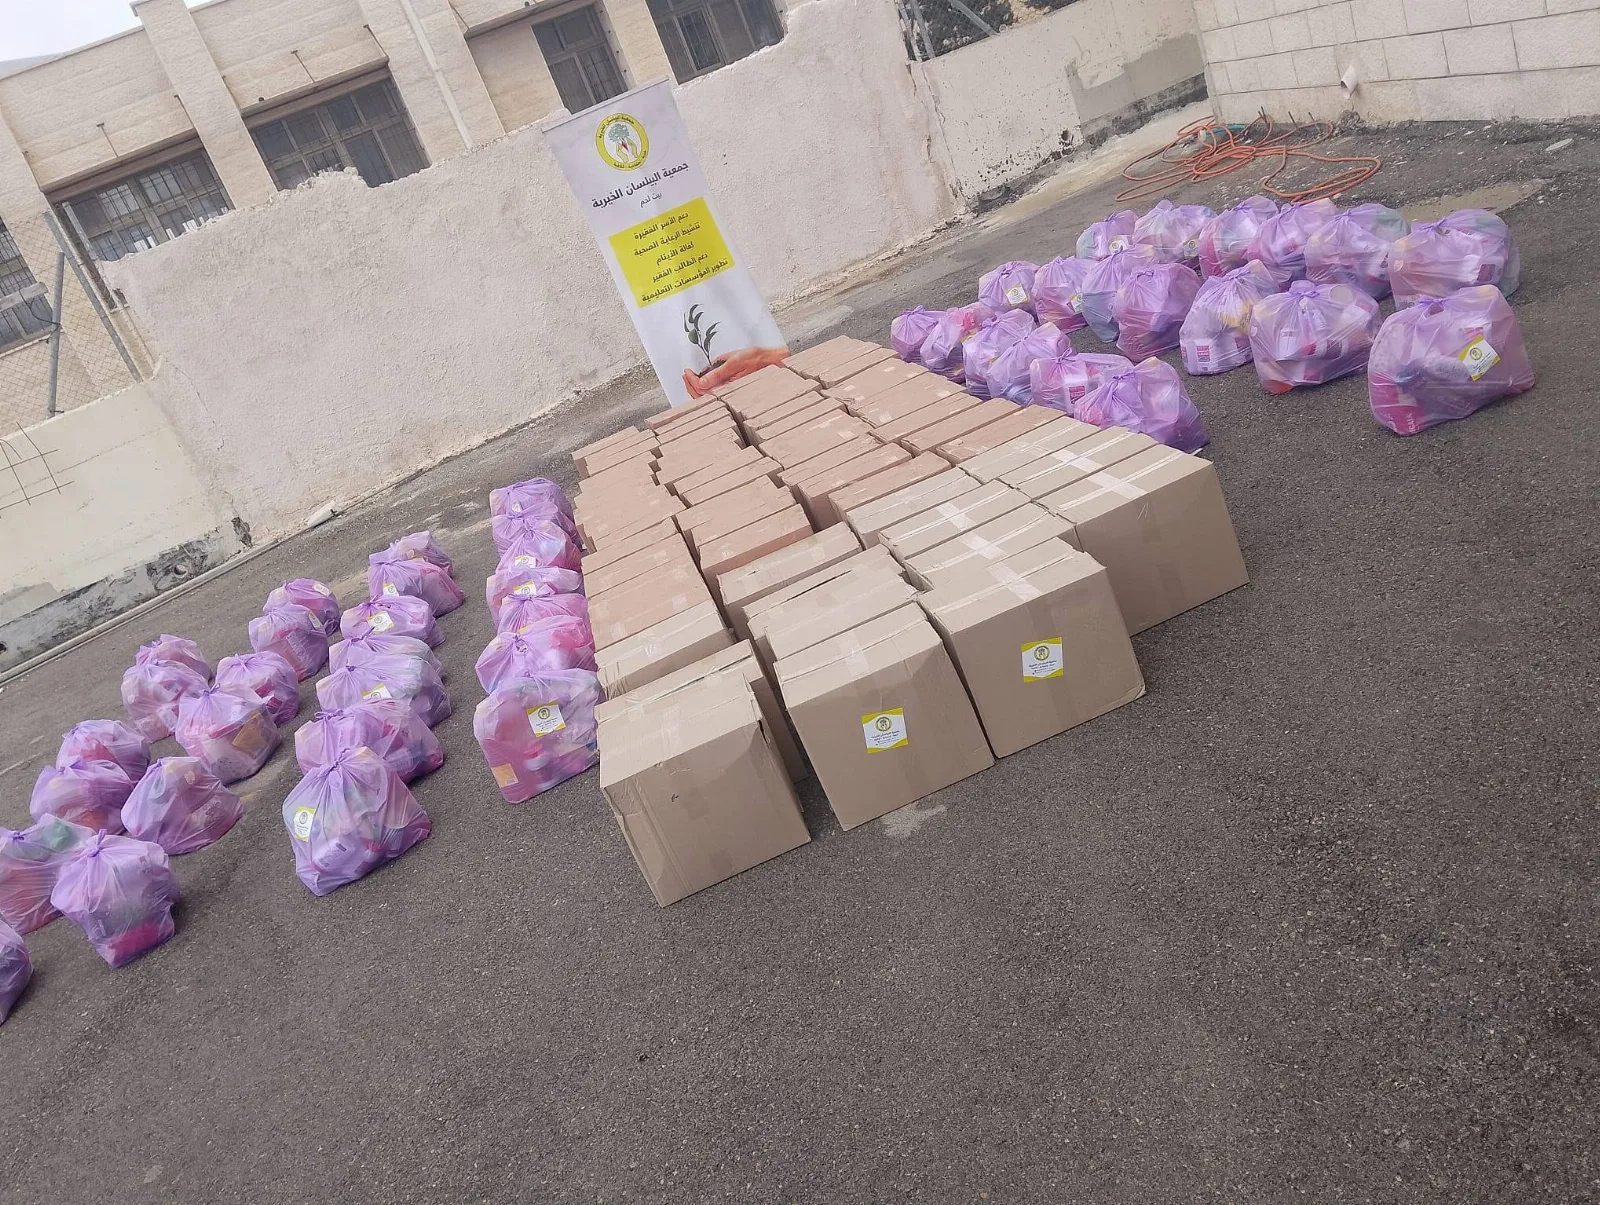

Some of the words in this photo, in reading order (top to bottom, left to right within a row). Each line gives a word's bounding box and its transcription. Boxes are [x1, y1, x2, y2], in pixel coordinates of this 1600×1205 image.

[662, 162, 689, 178] جمعية
[625, 171, 661, 195] البيلسان
[592, 188, 624, 208] الخيرية
[640, 195, 651, 208] لحم
[660, 216, 677, 230] الأسر
[677, 212, 689, 224] دعم
[634, 224, 659, 240] الفقيرة
[660, 230, 681, 246] الرعاية
[633, 242, 659, 257] الصحية
[680, 241, 695, 254] كفالة
[674, 256, 697, 272] الطالب
[697, 253, 708, 264] دعم
[712, 259, 728, 273] تطوير
[652, 268, 672, 283] الفقير
[674, 266, 711, 288] المؤسسات
[642, 284, 673, 302] التعليمية
